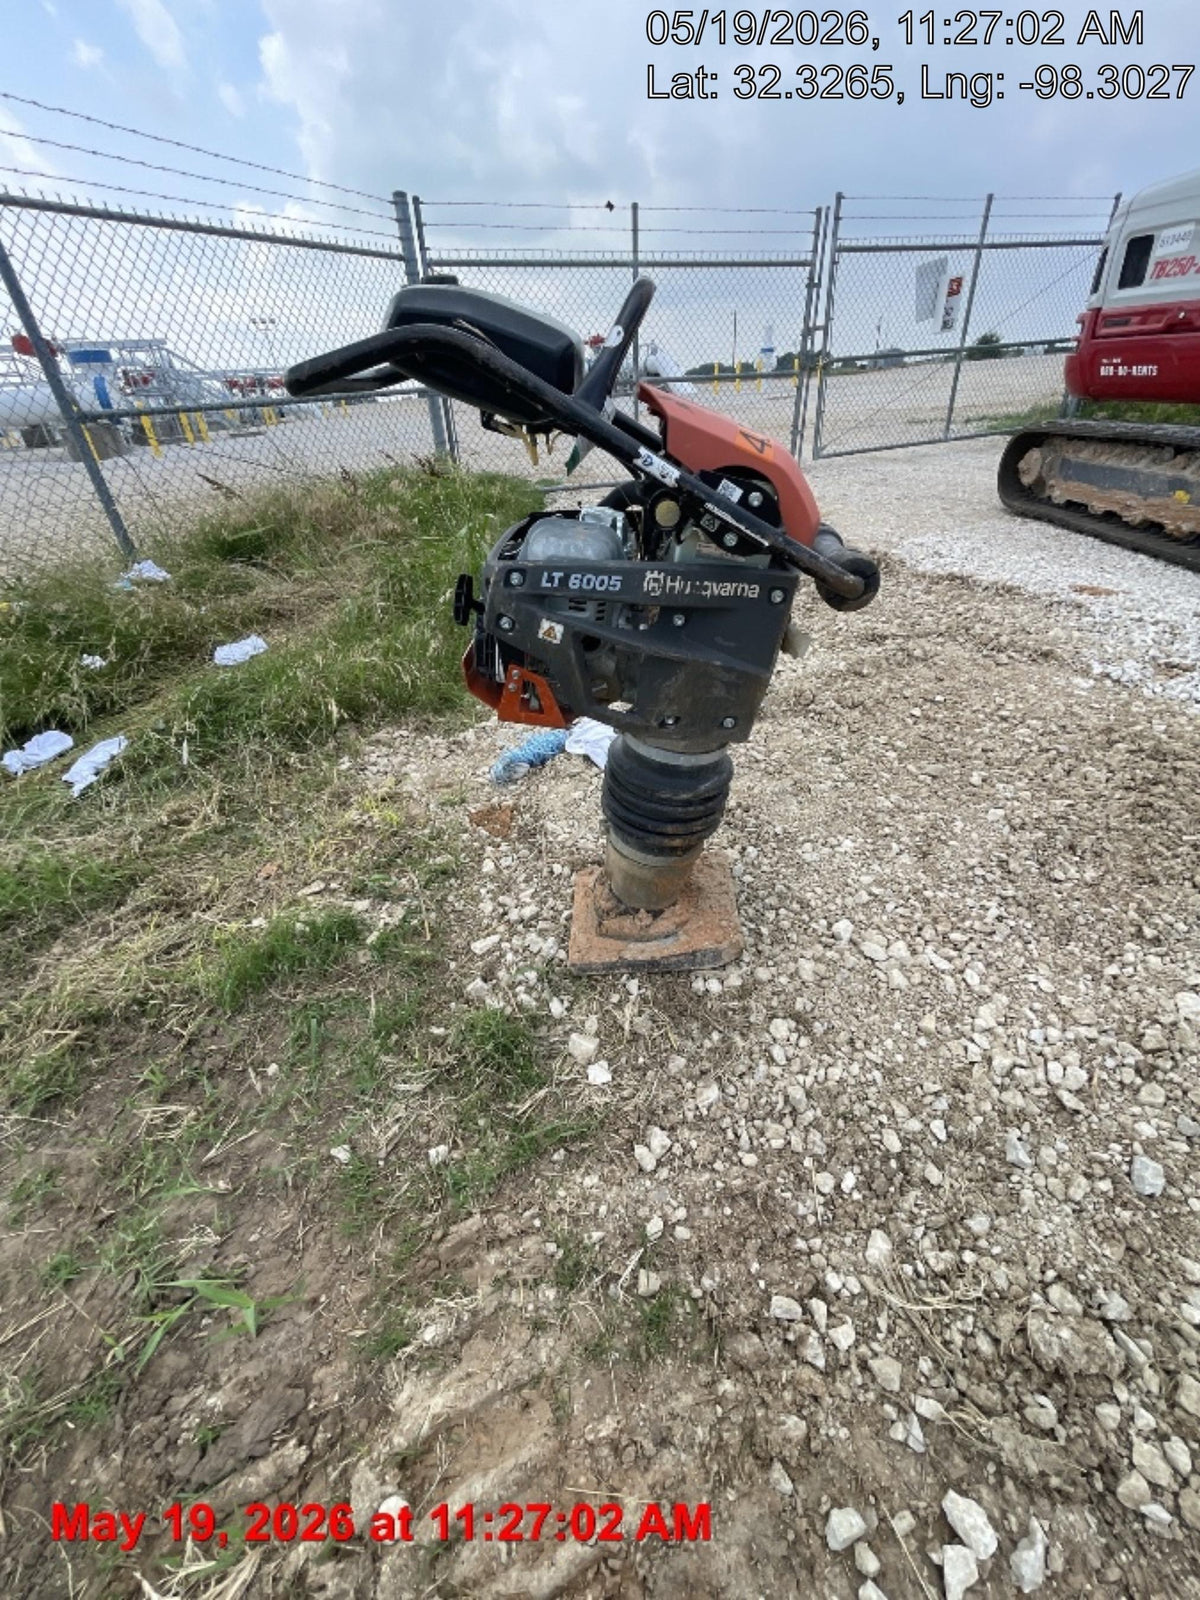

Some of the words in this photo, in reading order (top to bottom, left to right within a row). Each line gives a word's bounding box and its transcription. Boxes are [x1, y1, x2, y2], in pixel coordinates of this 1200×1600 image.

[540, 571, 564, 588] LT
[568, 573, 623, 592] 6005
[665, 575, 760, 599] Huqvarna
